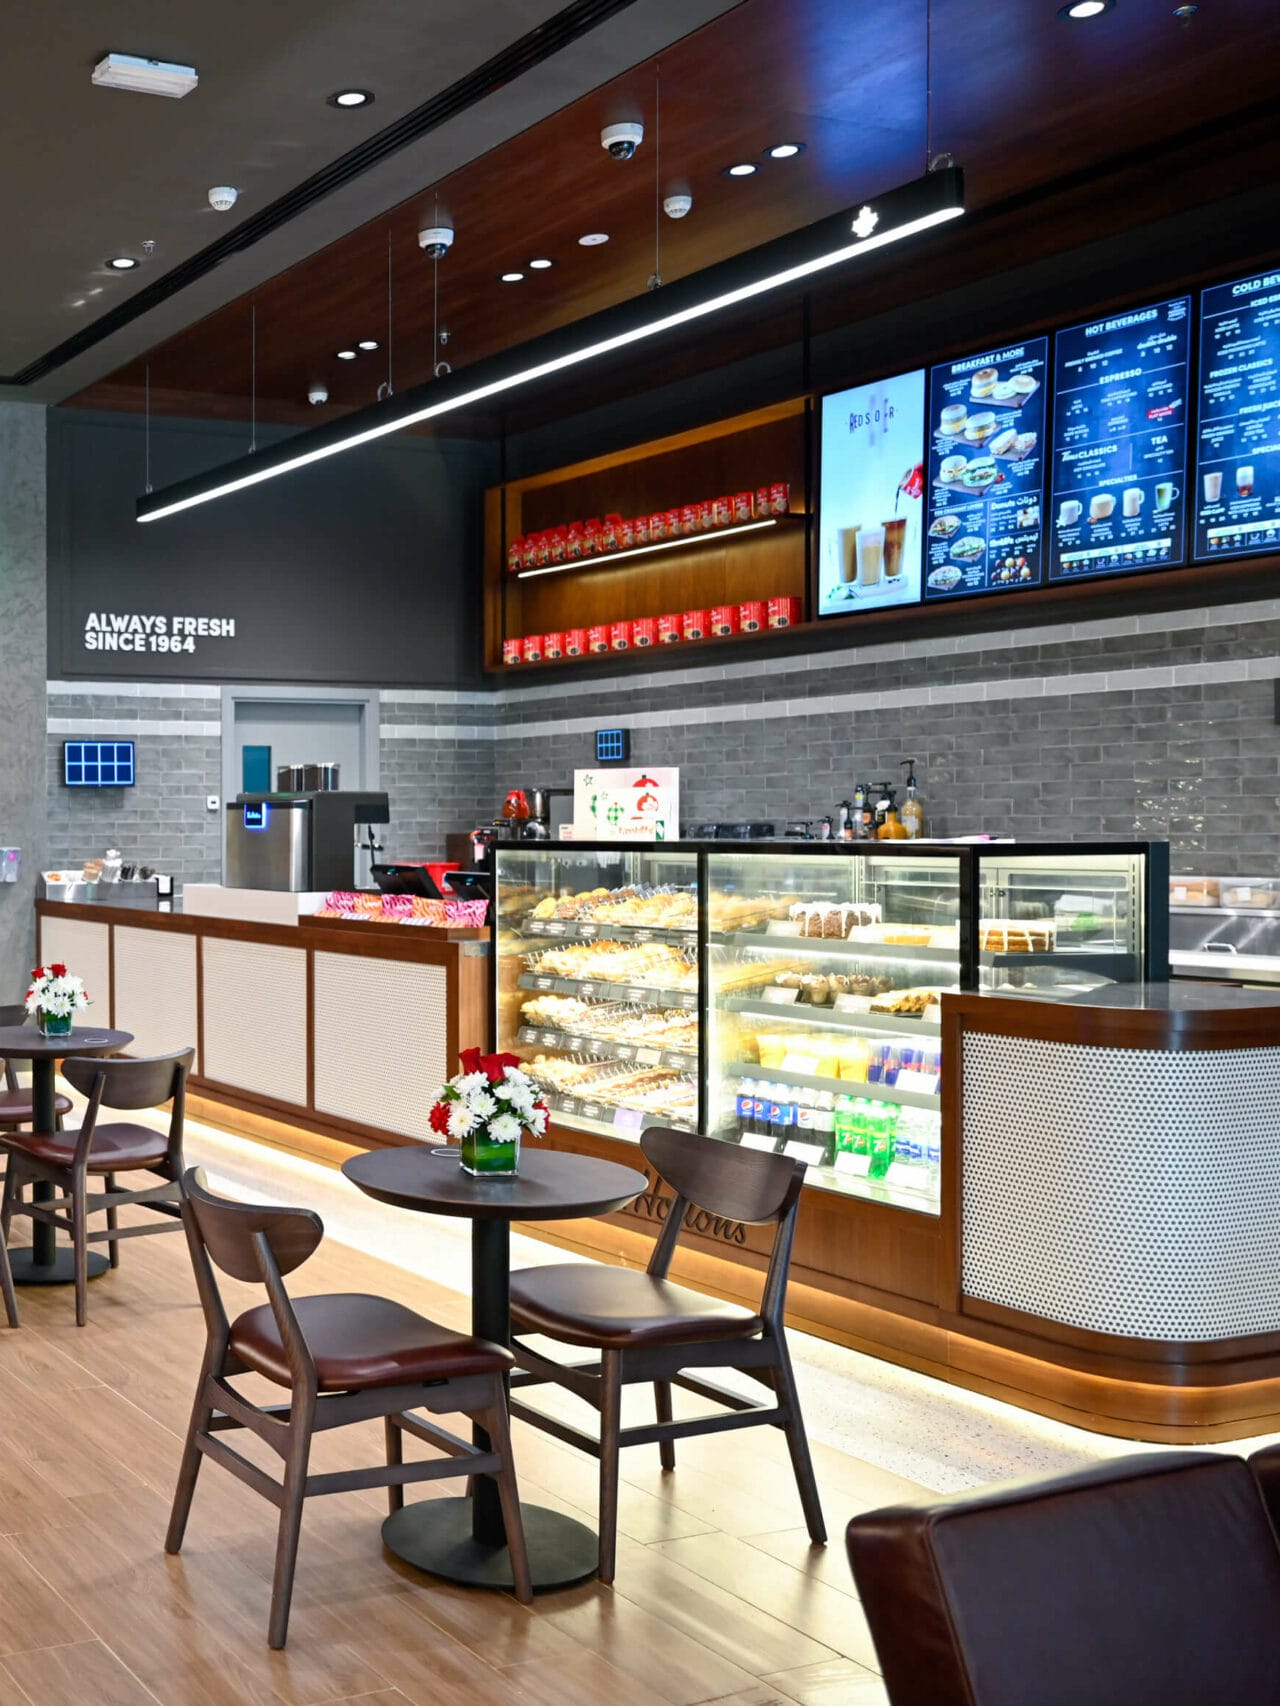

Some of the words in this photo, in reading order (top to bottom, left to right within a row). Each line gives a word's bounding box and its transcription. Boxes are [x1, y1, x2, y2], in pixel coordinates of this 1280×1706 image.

[1232, 279, 1261, 295] COLD
[1085, 323, 1104, 337] HOT
[1105, 309, 1158, 330] BEVERAGES
[951, 354, 995, 375] BREAKFAST
[1002, 346, 1024, 360] MORE
[1099, 368, 1142, 385] ESPRESSO
[1150, 435, 1168, 445] TEA
[1078, 444, 1118, 460] CLASSICS
[991, 500, 1016, 510] Donuts
[85, 612, 168, 634] ALWAYS
[172, 617, 235, 637] FRESH
[84, 632, 146, 652] SINCE
[148, 635, 196, 653] 1964
